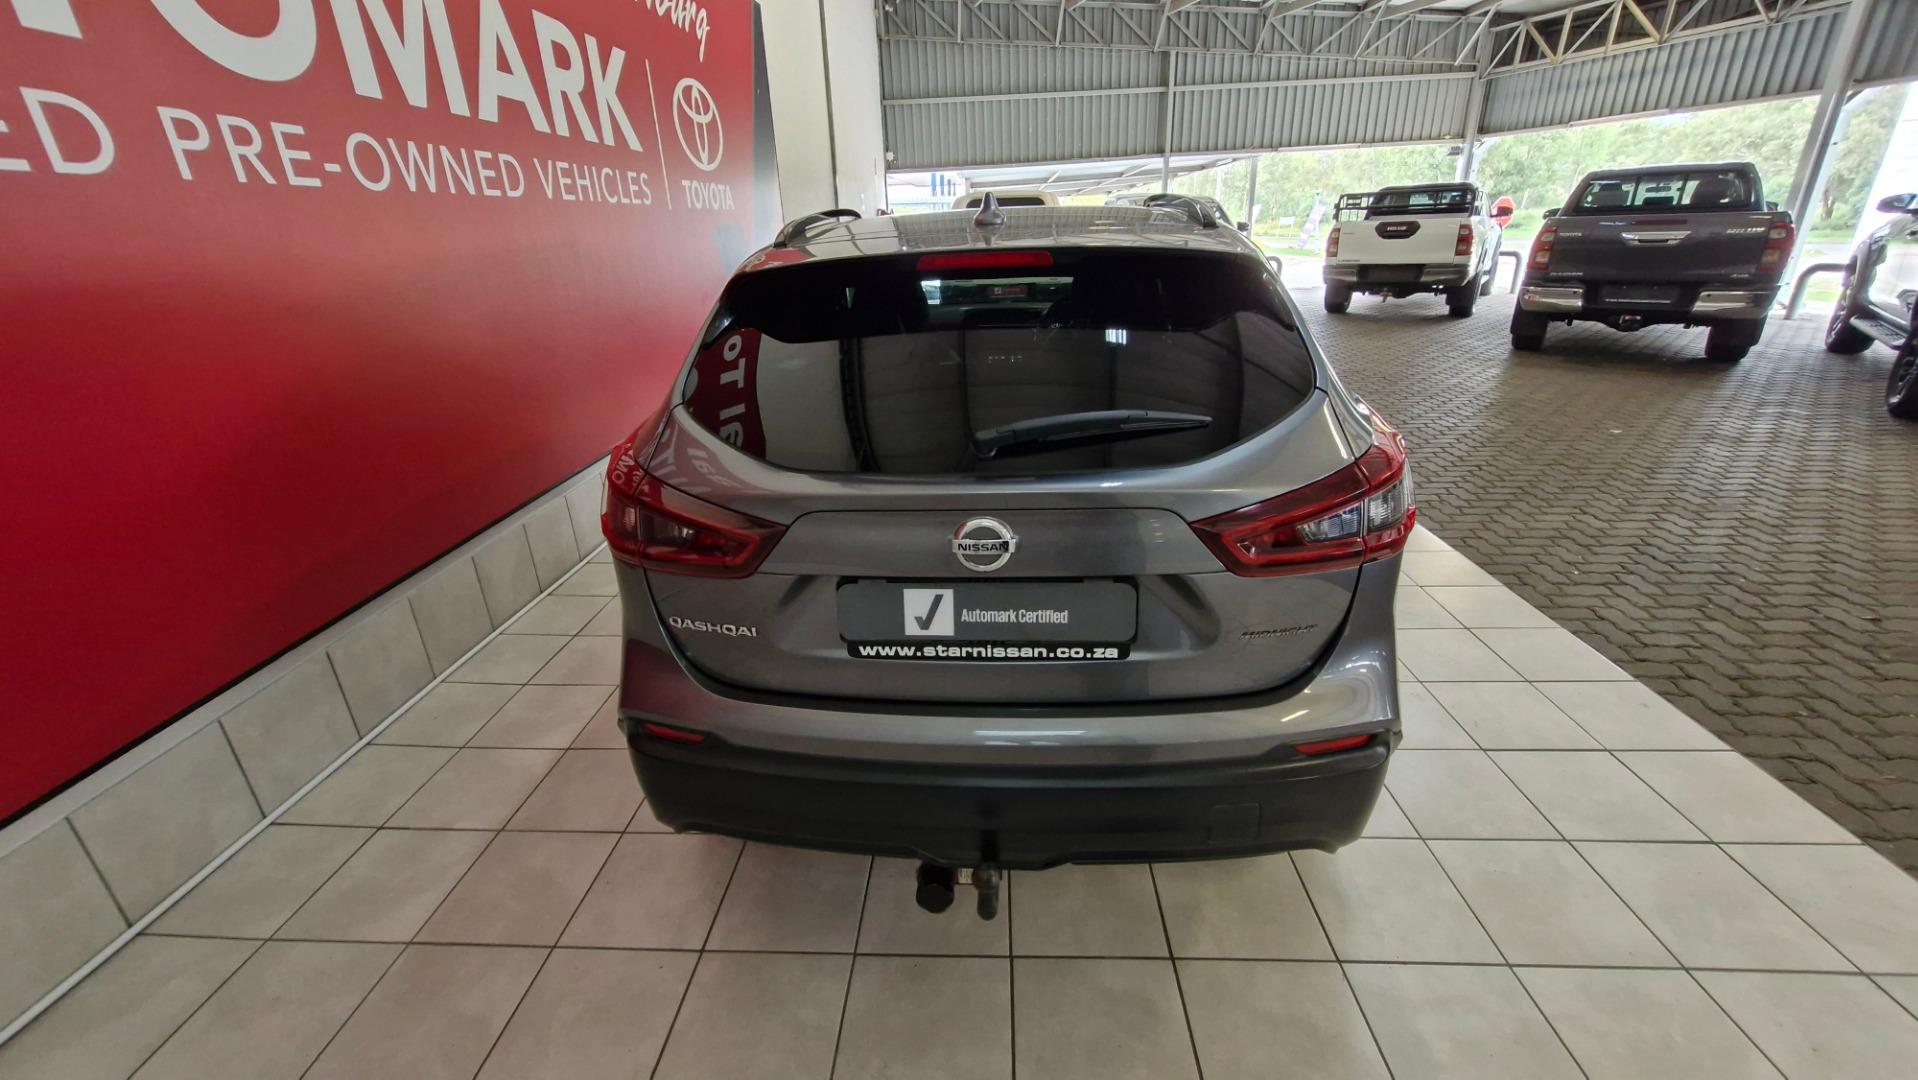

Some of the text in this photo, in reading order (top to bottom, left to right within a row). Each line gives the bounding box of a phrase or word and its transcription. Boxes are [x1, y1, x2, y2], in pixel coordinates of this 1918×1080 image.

[644, 0, 710, 63] urg
[10, 0, 644, 152] MARK
[0, 86, 652, 205] D PRE-OWNED VEHICLES
[682, 179, 735, 210] TOYOTA
[957, 543, 1009, 552] NISSAN
[668, 616, 757, 638] QASHQAI
[961, 608, 1069, 625] Automark Certified
[858, 644, 1119, 659] www.starnissan.co.za
